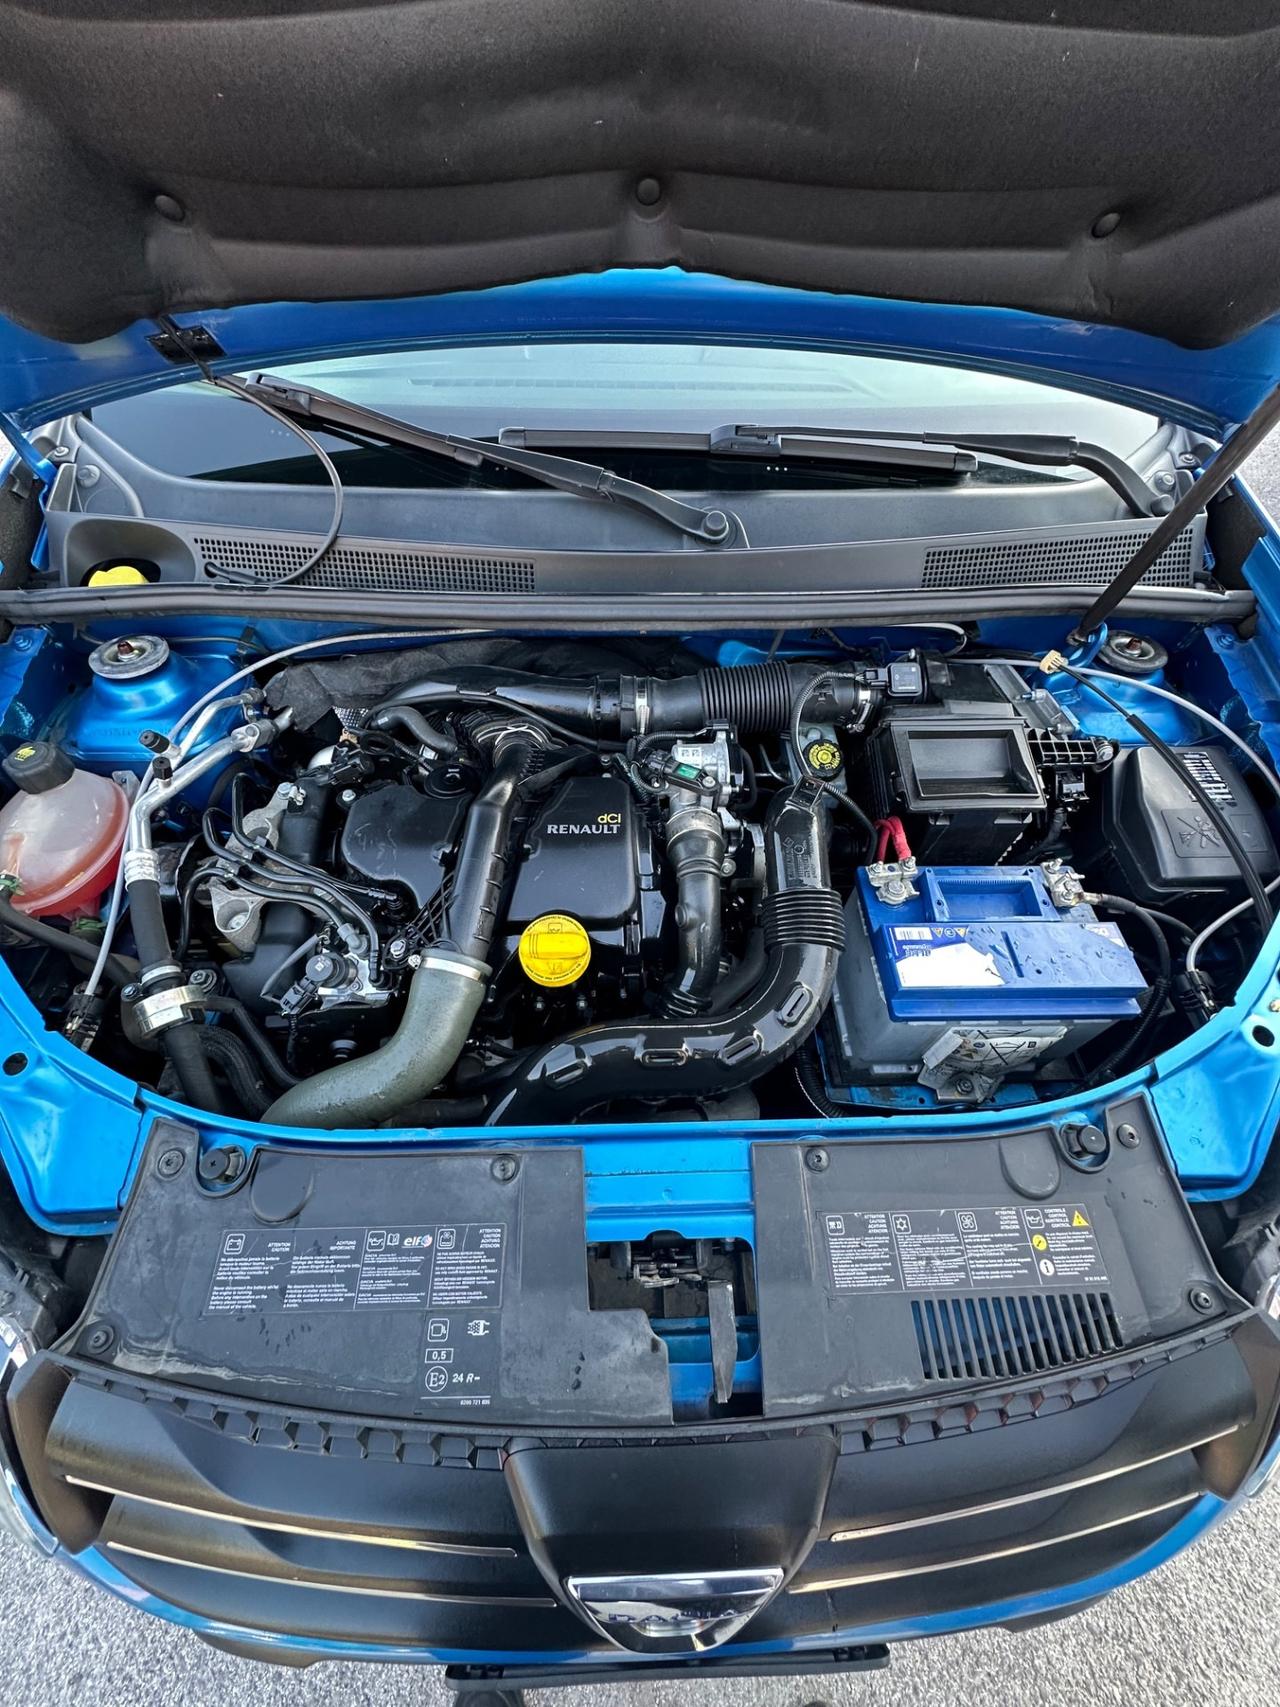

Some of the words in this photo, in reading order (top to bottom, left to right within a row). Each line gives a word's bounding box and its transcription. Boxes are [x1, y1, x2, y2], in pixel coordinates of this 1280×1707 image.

[546, 824, 621, 834] RENAULT
[403, 1236, 422, 1246] elf
[432, 1351, 446, 1361] 0,5
[429, 1372, 445, 1387] E2
[452, 1373, 464, 1383] 24
